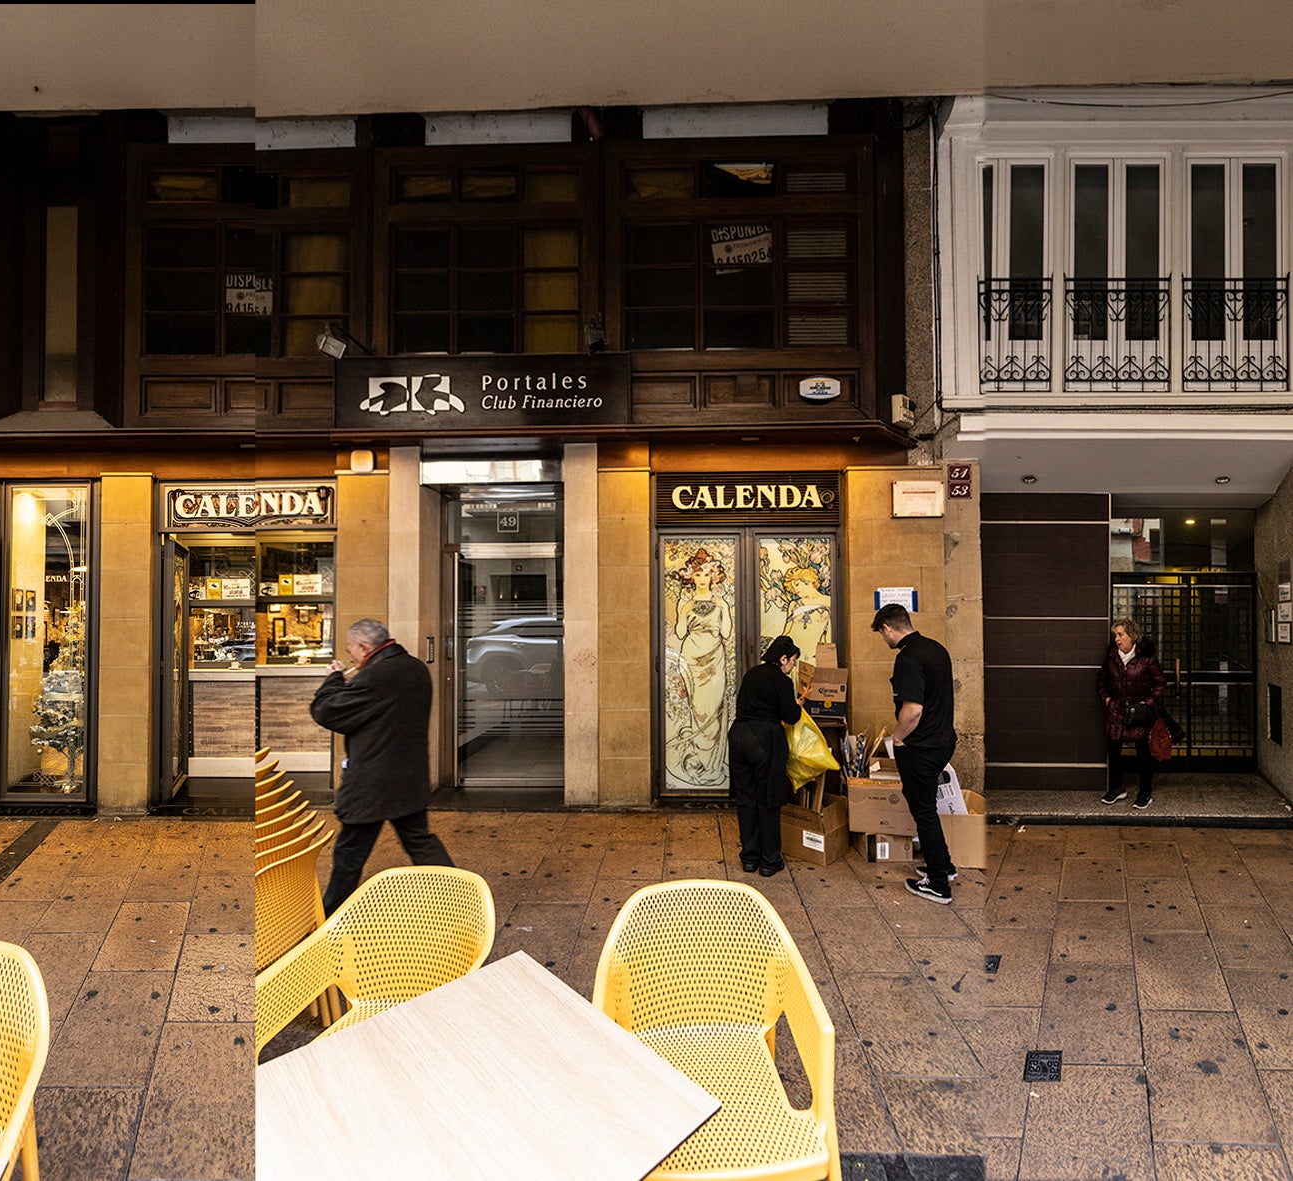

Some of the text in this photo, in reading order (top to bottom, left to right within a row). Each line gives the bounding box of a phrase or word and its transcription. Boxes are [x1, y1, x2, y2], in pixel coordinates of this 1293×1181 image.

[482, 372, 588, 391] Portales
[481, 393, 603, 410] Club Financiero
[951, 468, 969, 478] 51
[671, 484, 824, 510] CALENDA
[951, 485, 969, 496] 53
[174, 491, 325, 519] CALENDA
[500, 516, 517, 527] 49
